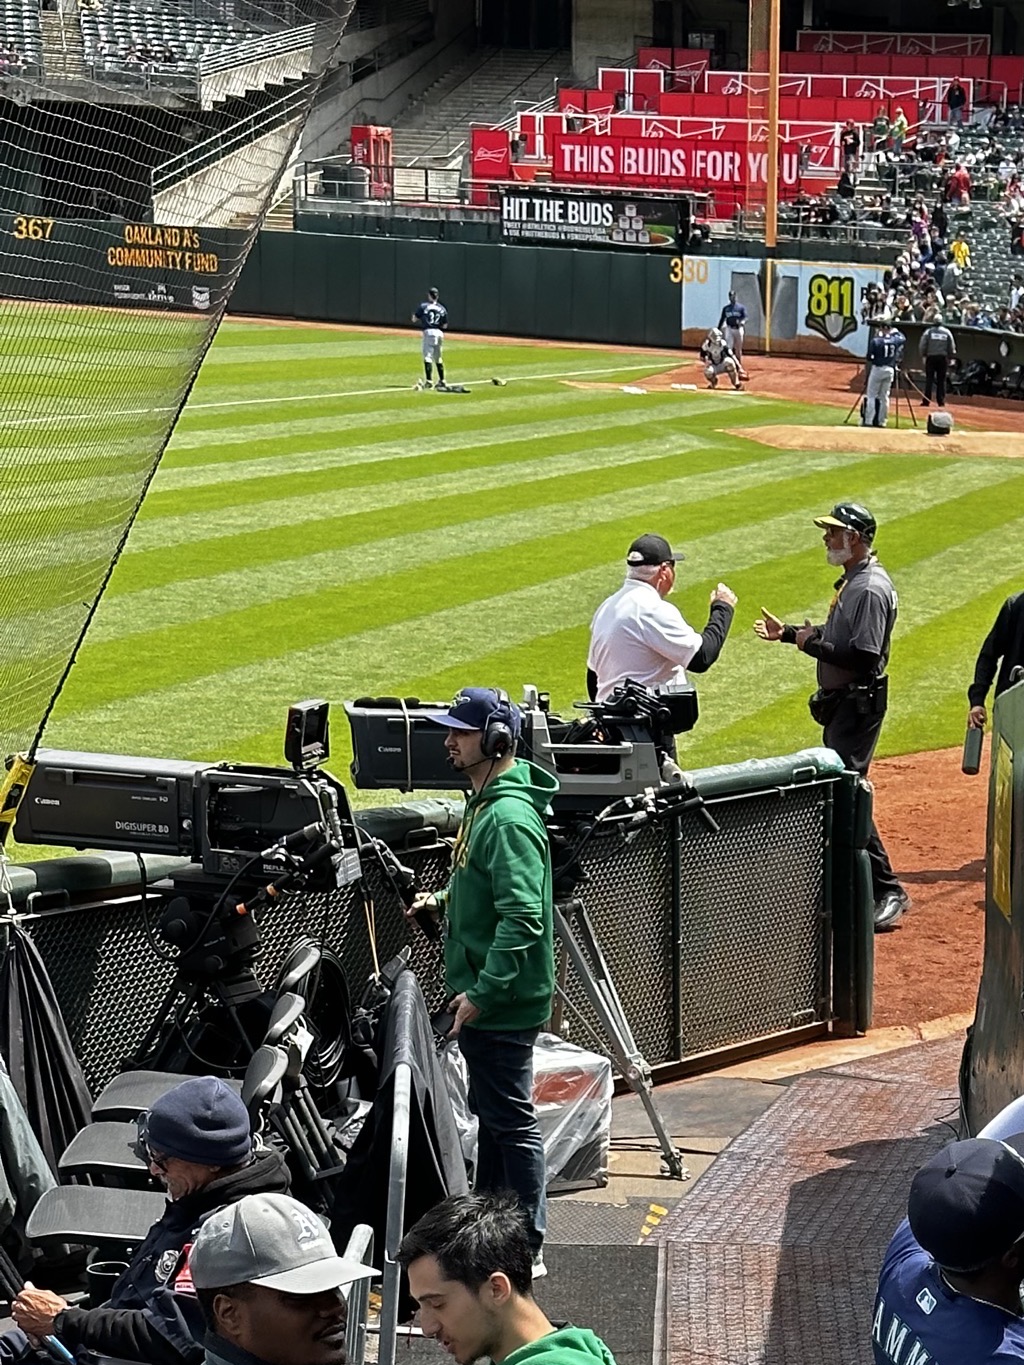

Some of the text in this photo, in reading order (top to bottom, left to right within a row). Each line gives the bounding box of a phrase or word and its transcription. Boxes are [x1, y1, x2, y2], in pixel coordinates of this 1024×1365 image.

[560, 143, 614, 174] THIS
[622, 146, 686, 177] BUDS
[693, 149, 741, 183] FOR
[503, 197, 613, 226] HIT THE BUDS
[14, 217, 54, 240] 367
[125, 224, 200, 247] OAKLAND A's
[107, 247, 218, 272] COMMUNITY FUND
[670, 258, 709, 284] 330
[809, 276, 852, 317] 811
[34, 797, 60, 806] Canon
[115, 821, 157, 833] DIGISUPER
